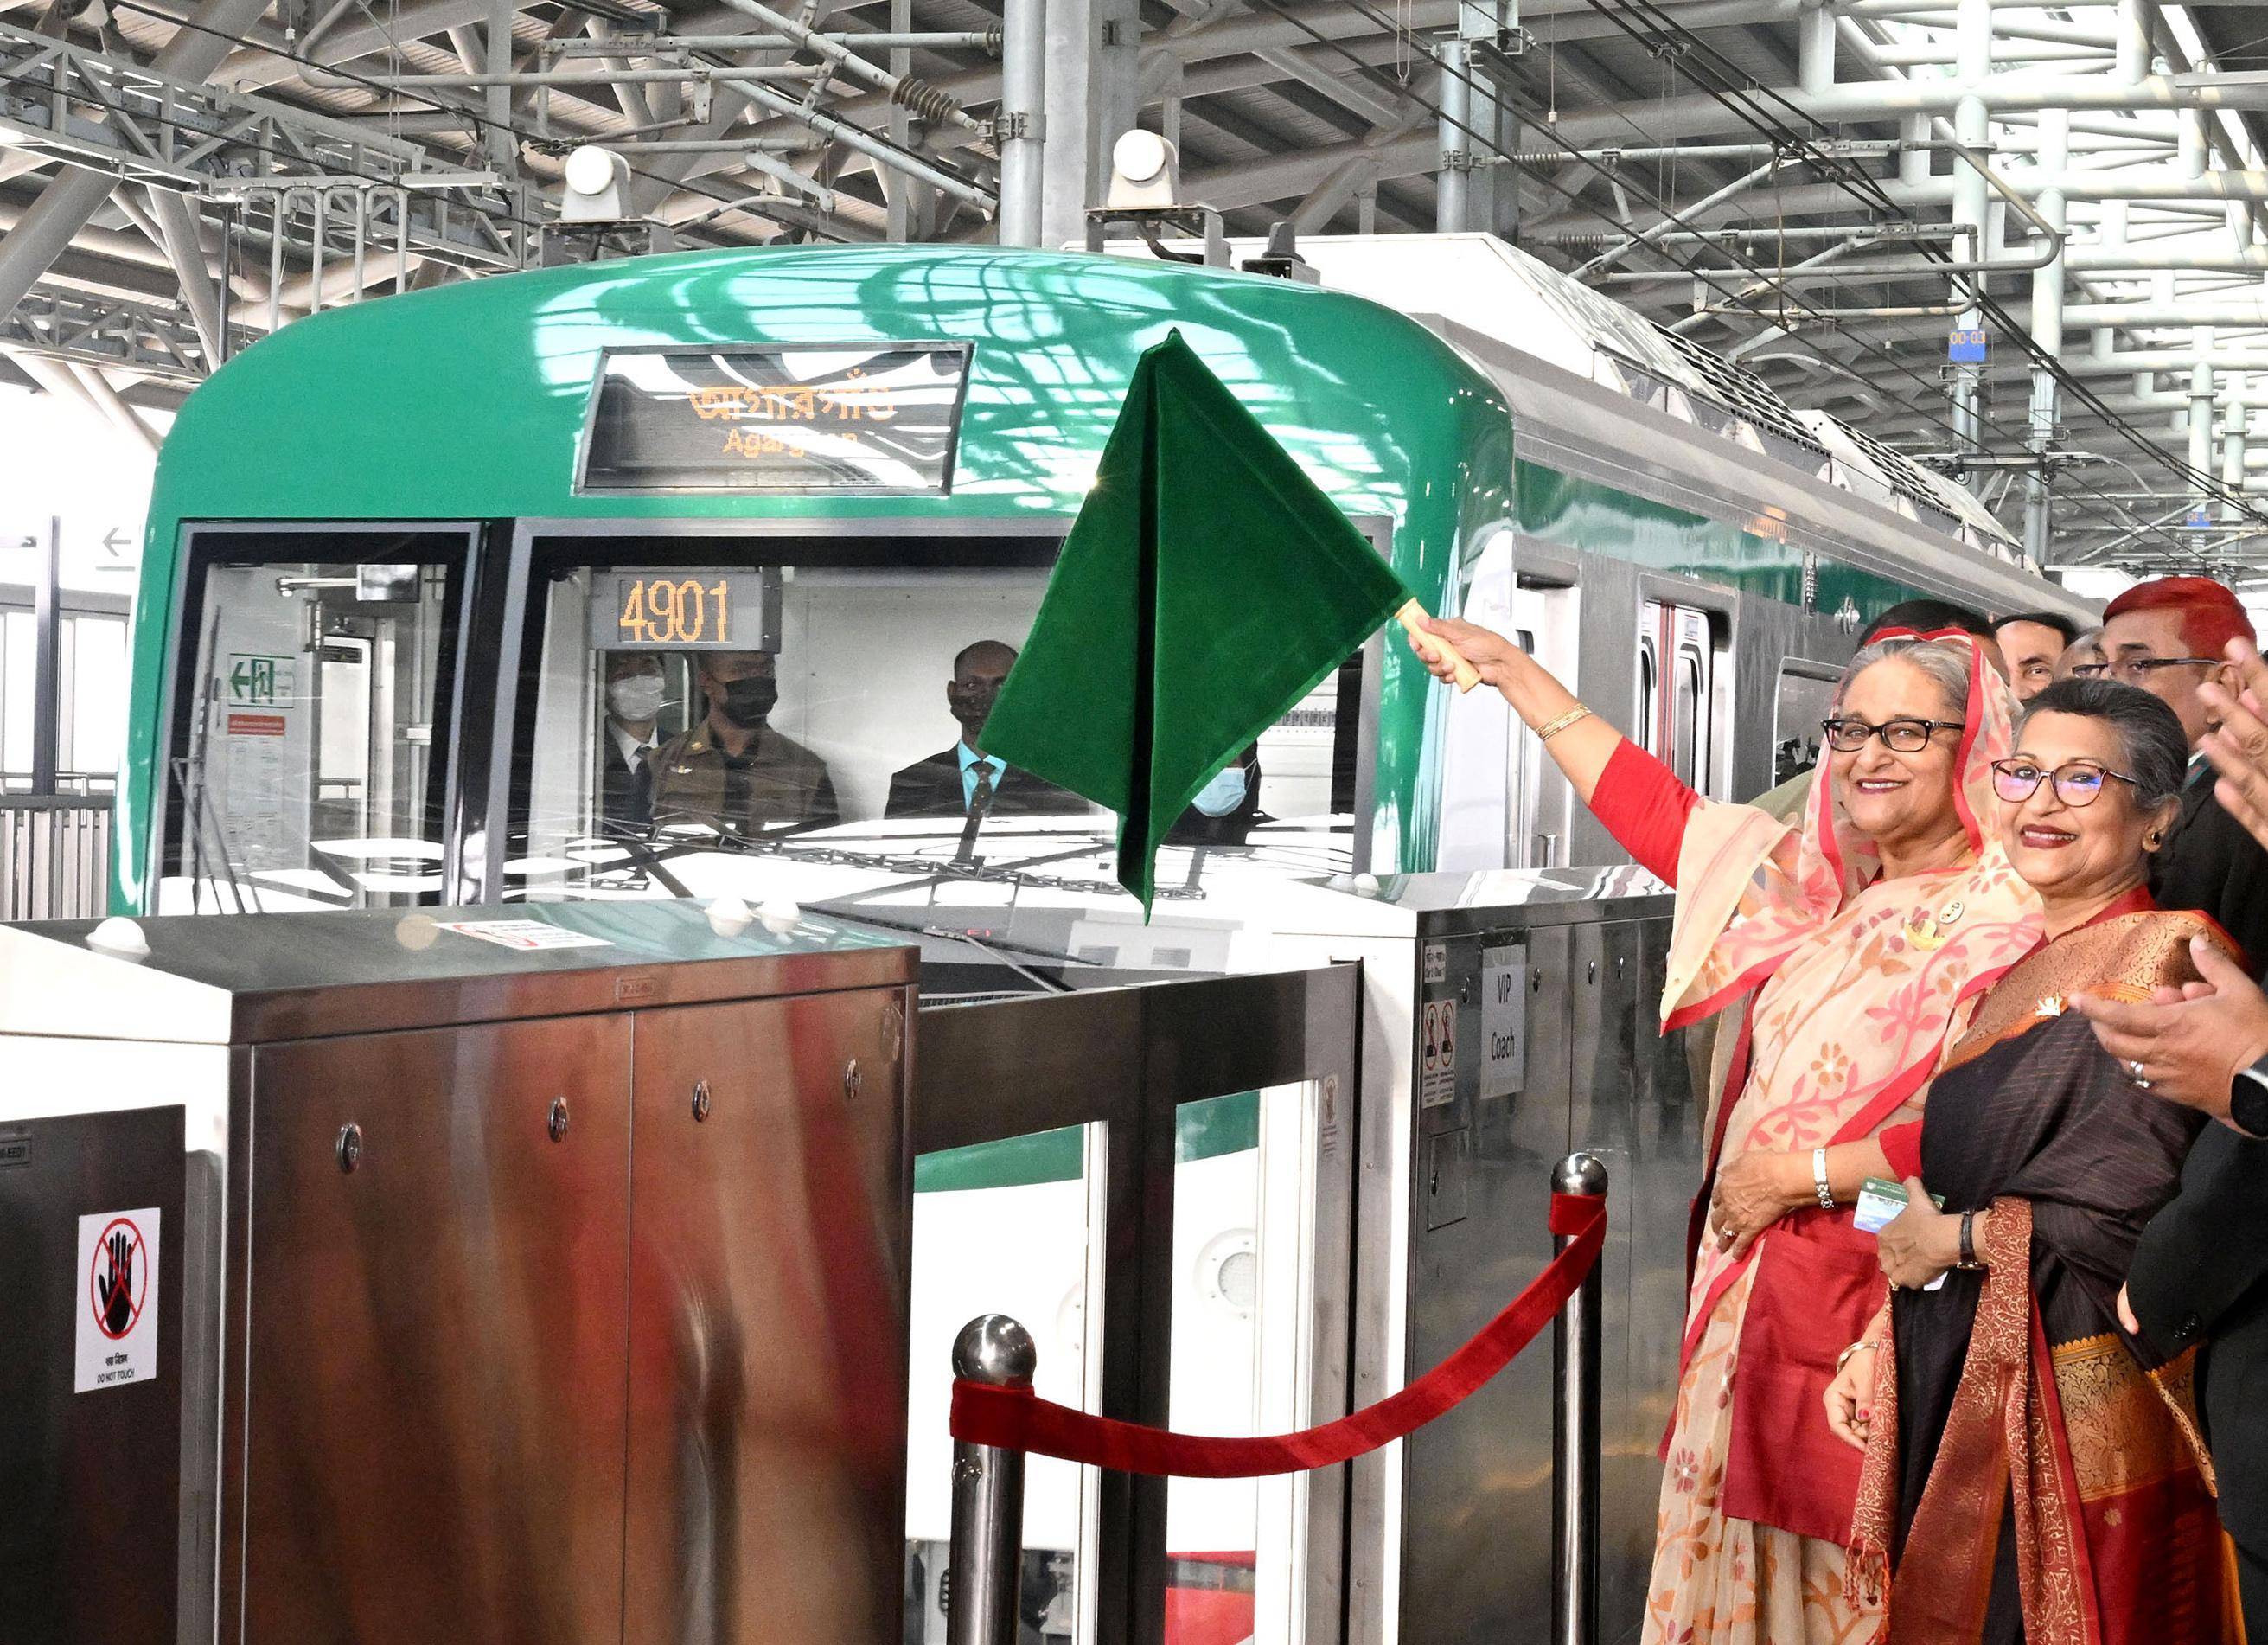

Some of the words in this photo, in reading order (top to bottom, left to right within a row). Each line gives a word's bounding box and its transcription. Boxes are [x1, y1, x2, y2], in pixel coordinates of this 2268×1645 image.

[620, 580, 728, 643] 4901
[1497, 973, 1511, 1004] VIP
[1491, 1027, 1515, 1061] Coach
